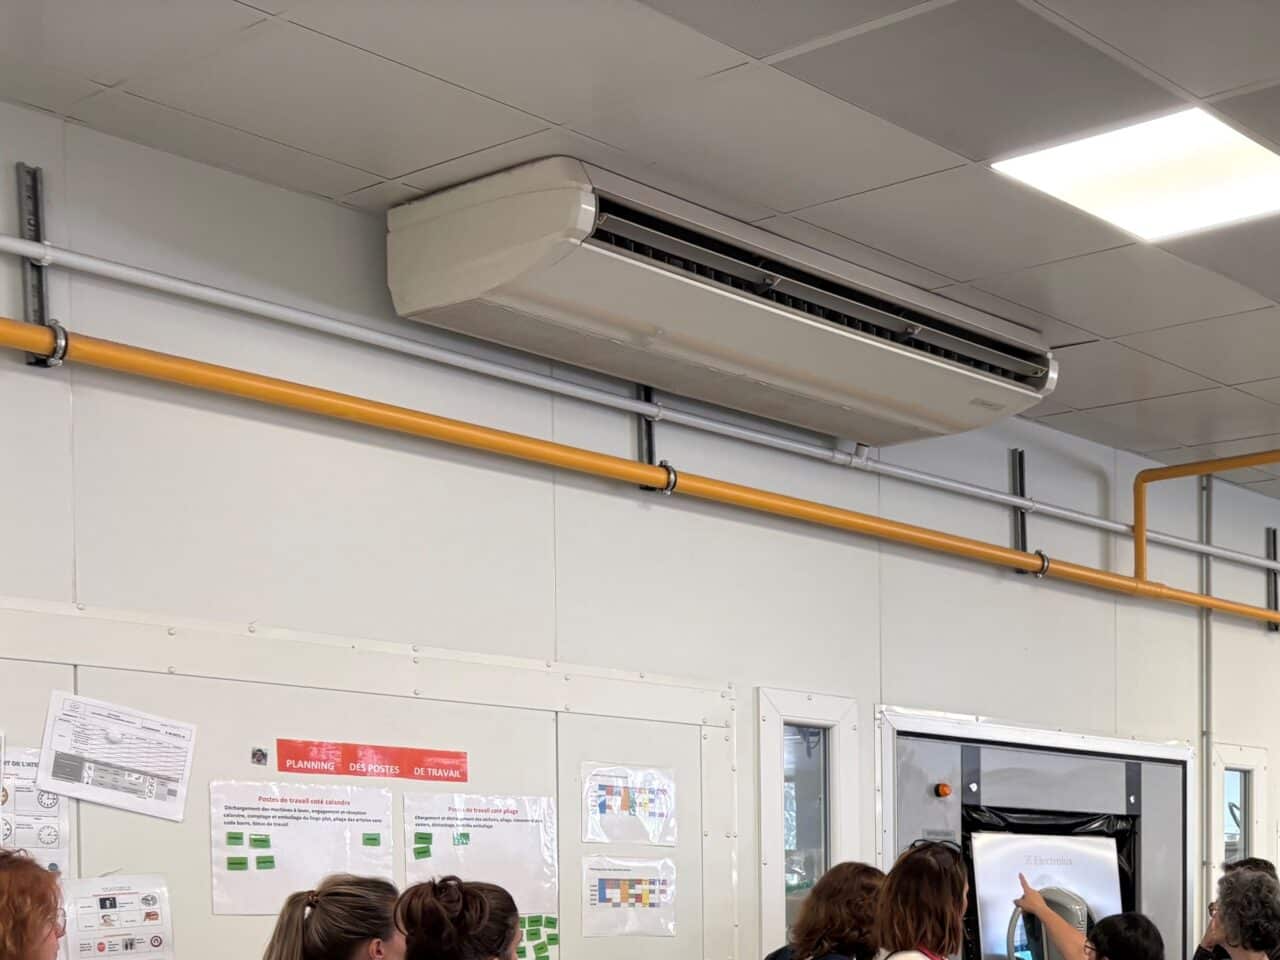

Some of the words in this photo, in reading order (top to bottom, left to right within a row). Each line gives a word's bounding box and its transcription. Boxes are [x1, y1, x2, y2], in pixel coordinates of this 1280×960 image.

[286, 759, 335, 771] PLANNING
[349, 762, 367, 772] DES
[368, 763, 400, 774] POSTES
[414, 767, 425, 776] DE
[427, 767, 461, 778] TRAVAIL
[257, 796, 279, 804] Postes
[289, 797, 309, 805] travail
